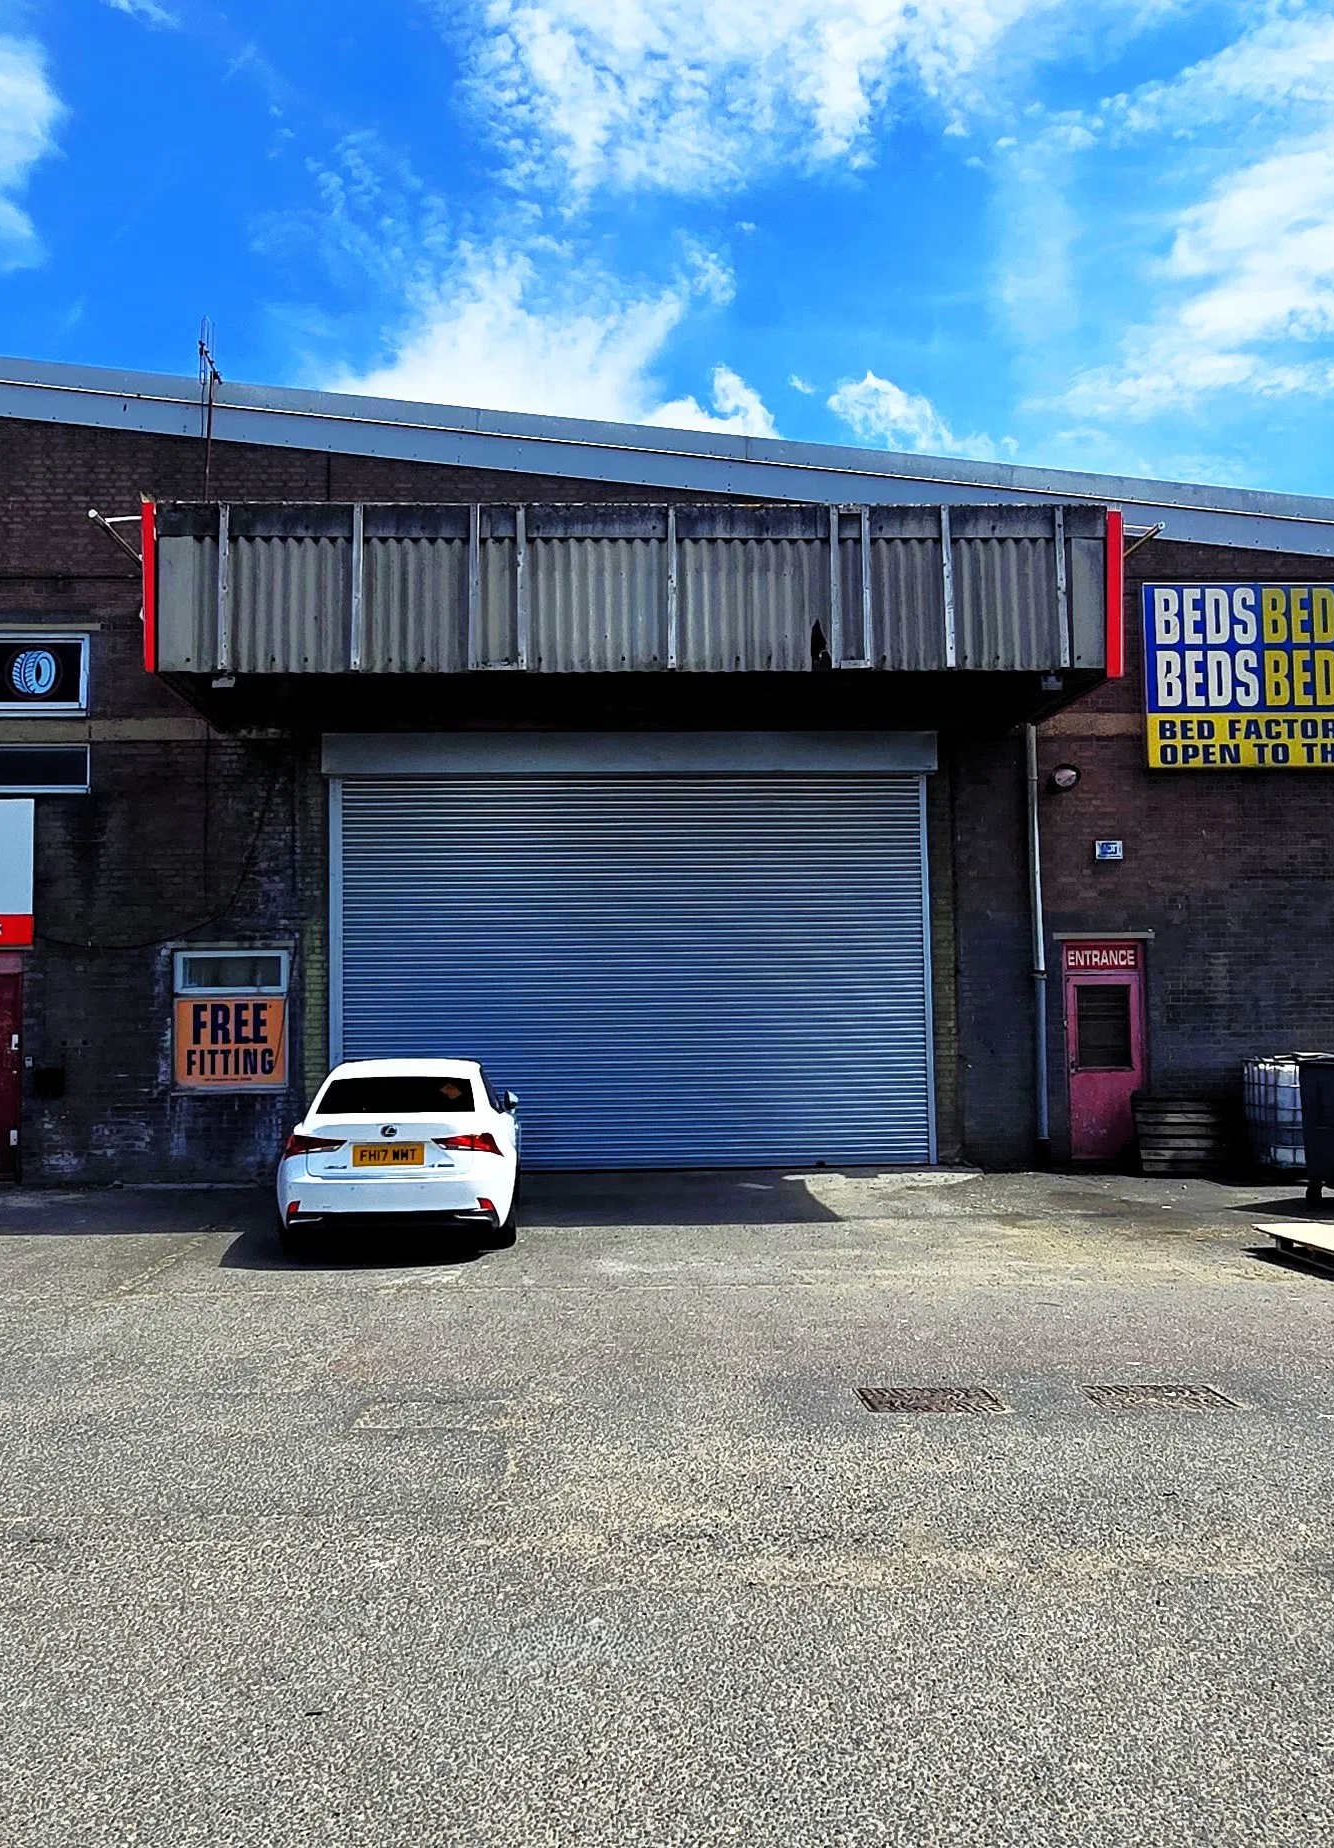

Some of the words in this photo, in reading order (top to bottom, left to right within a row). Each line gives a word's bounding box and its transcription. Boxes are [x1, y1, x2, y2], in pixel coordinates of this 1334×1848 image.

[1153, 587, 1257, 645] BEDS
[1157, 649, 1259, 707] BEDS
[1158, 719, 1215, 741] BED
[1159, 743, 1241, 765] OPEN
[1253, 743, 1290, 764] TO
[1068, 949, 1136, 966] ENTRANCE
[186, 1048, 274, 1076] FITTING
[359, 1149, 388, 1162] FH17
